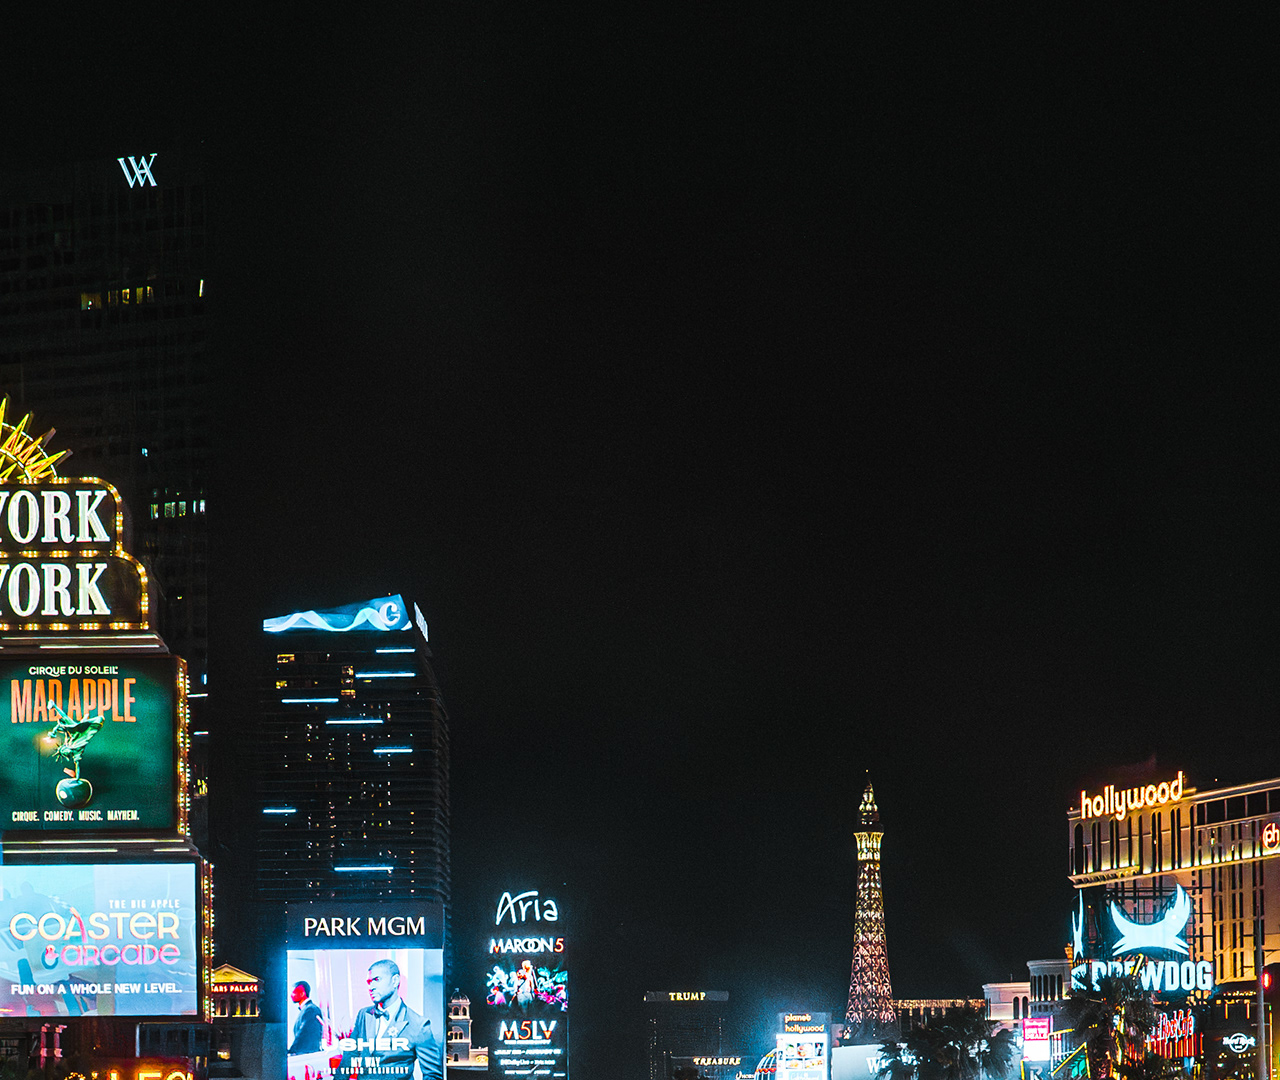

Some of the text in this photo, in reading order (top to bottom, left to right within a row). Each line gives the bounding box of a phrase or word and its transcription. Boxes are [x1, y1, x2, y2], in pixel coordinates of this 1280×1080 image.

[28, 665, 119, 677] CIRQUE DU SOLEIL
[11, 678, 137, 723] MAD APPLE
[1081, 771, 1184, 821] hollywood
[11, 810, 140, 822] CIRQUE. COMEDY. MUSIC. MAYHEM.
[109, 898, 180, 909] THE BIG APPLE
[495, 890, 558, 925] Aria
[304, 916, 425, 938] PARK MGM
[489, 937, 564, 954] MAROON 5
[11, 982, 183, 995] FUN ON A WHOLE NEW LEVEL.
[669, 992, 706, 1001] TRUMP
[784, 1014, 811, 1023] planet
[498, 1020, 557, 1040] M5LV
[784, 1024, 825, 1033] hollywood
[321, 1038, 410, 1051] USHER
[693, 1057, 741, 1066] TREASURE
